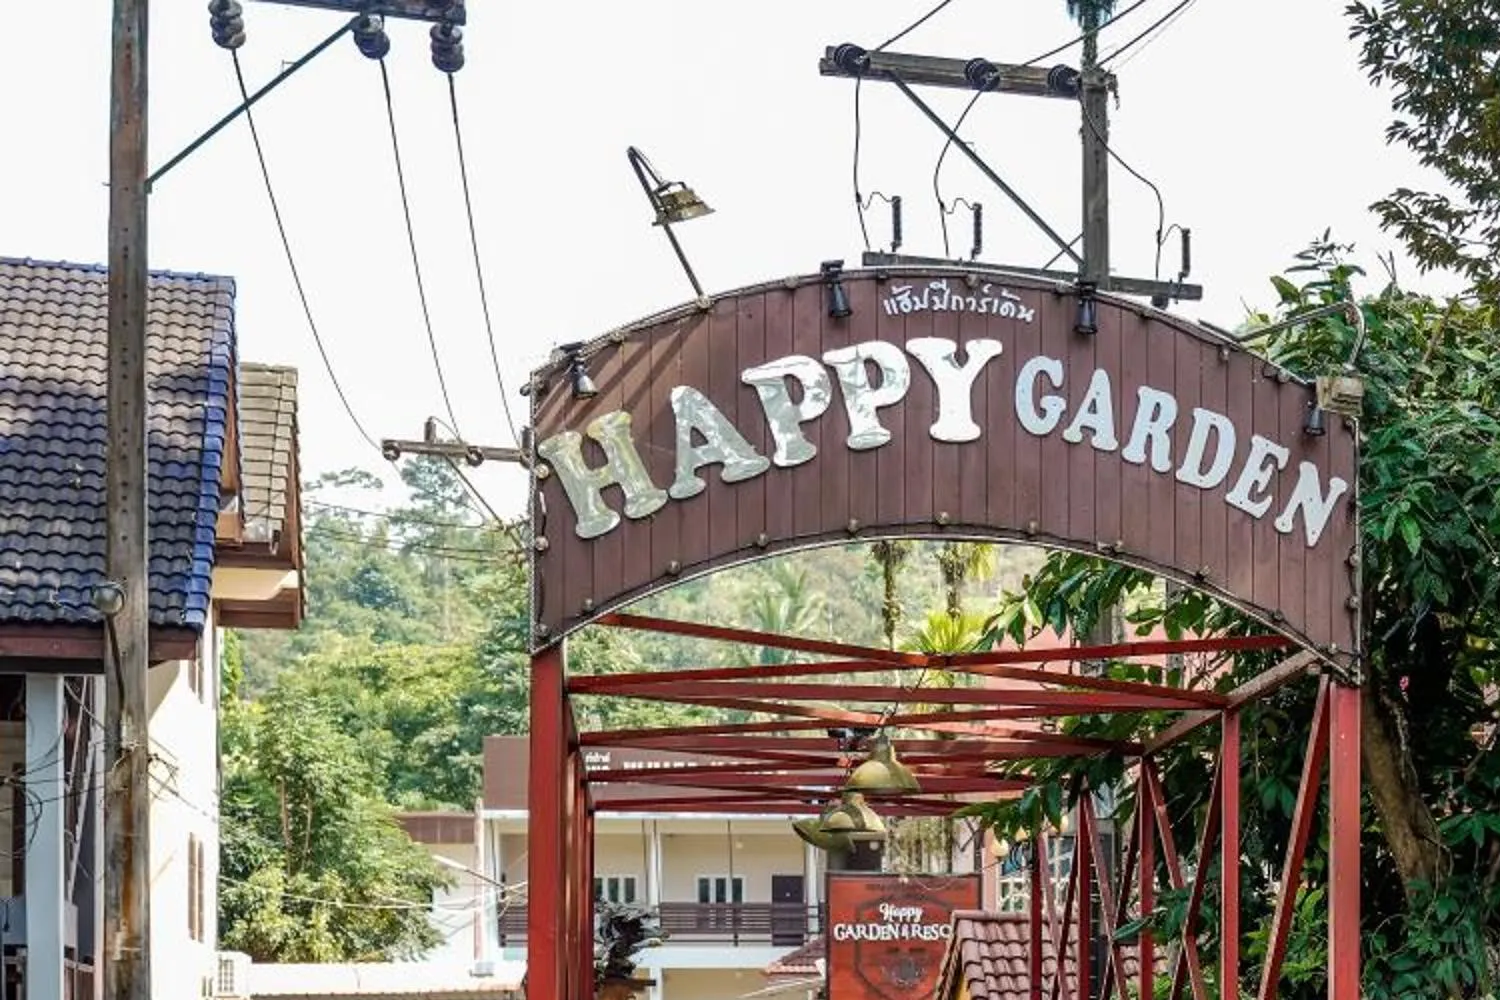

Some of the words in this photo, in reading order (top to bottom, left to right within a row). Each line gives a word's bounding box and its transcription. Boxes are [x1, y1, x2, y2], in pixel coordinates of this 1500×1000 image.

[537, 337, 1003, 540] HAPPY
[1014, 354, 1347, 548] GARDEN
[880, 902, 924, 922] Happy
[834, 923, 899, 940] GARDEN
